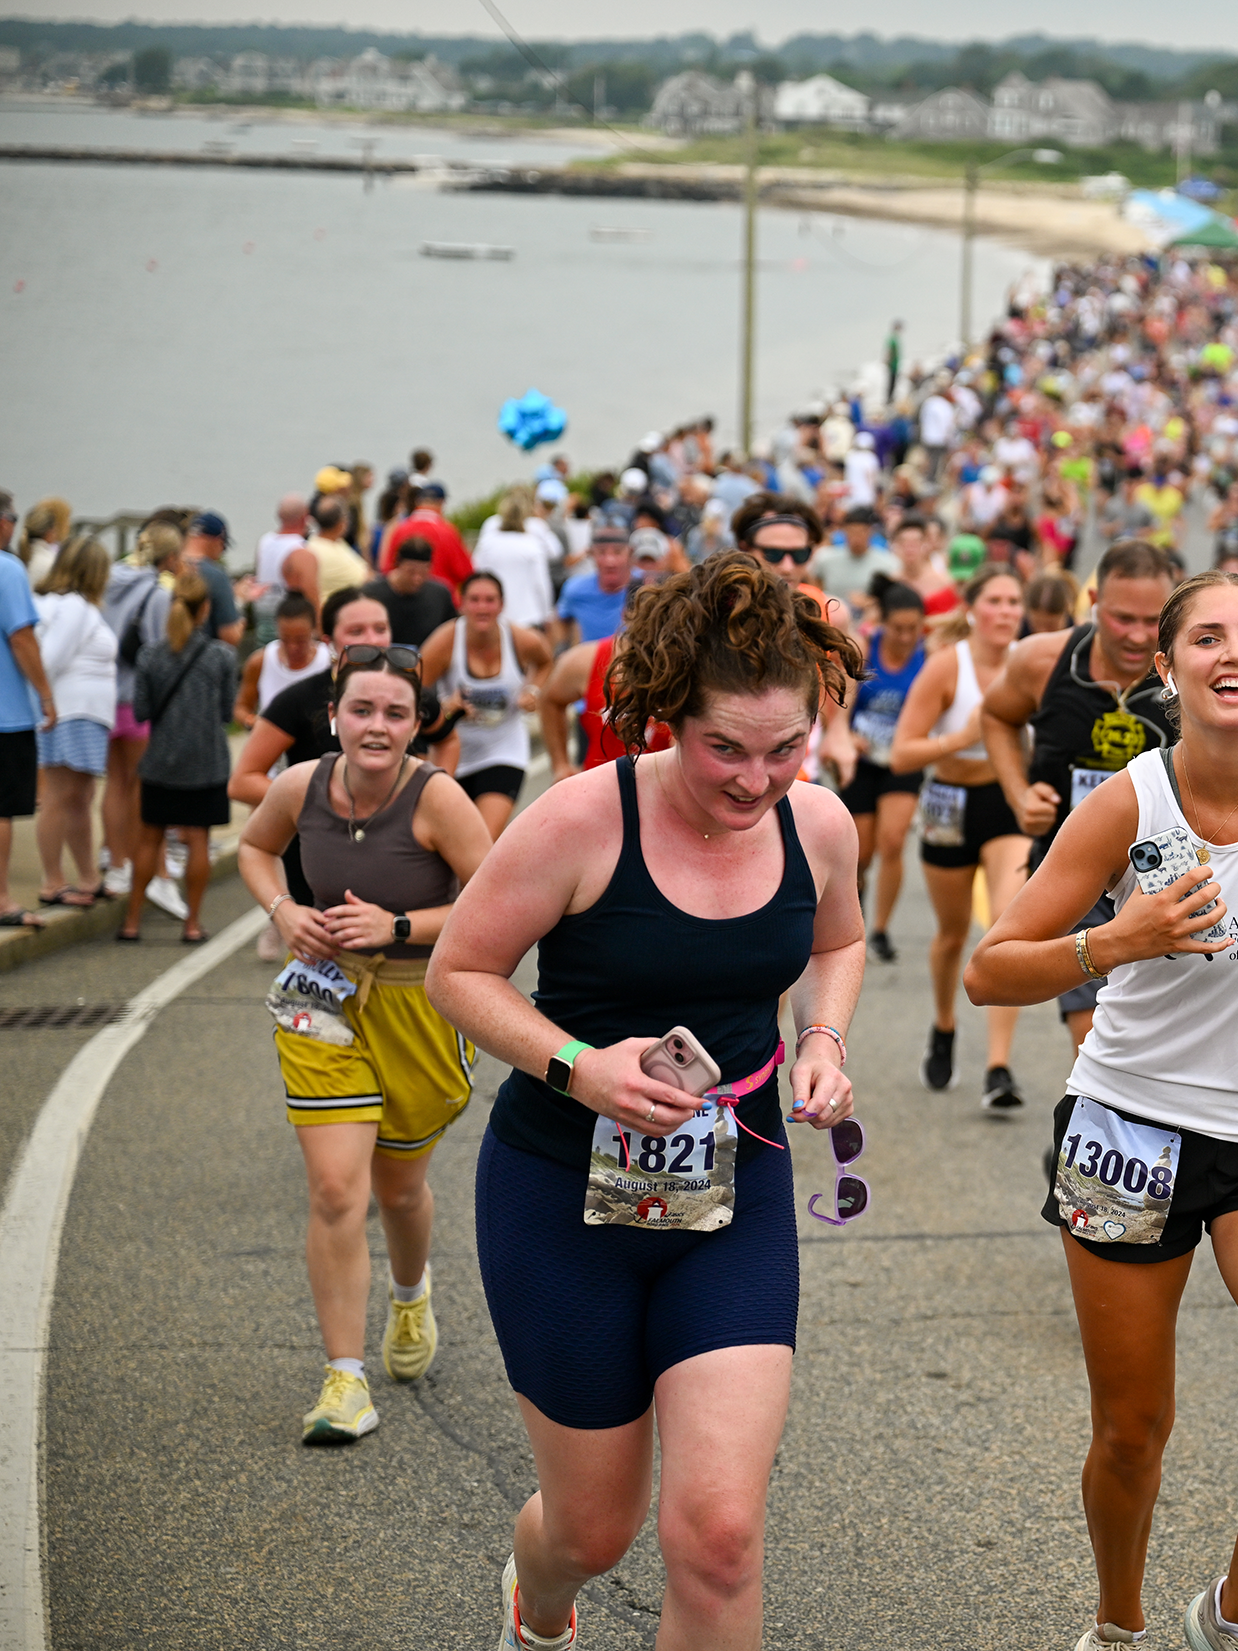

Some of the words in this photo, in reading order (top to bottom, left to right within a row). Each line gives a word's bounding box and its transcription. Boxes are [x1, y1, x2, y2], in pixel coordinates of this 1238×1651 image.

[612, 1131, 716, 1174] 1821
[1064, 1133, 1173, 1200] 13008
[615, 1177, 658, 1192] August
[662, 1181, 679, 1193] 18,
[684, 1178, 712, 1191] 2024
[1110, 1207, 1127, 1218] 2024
